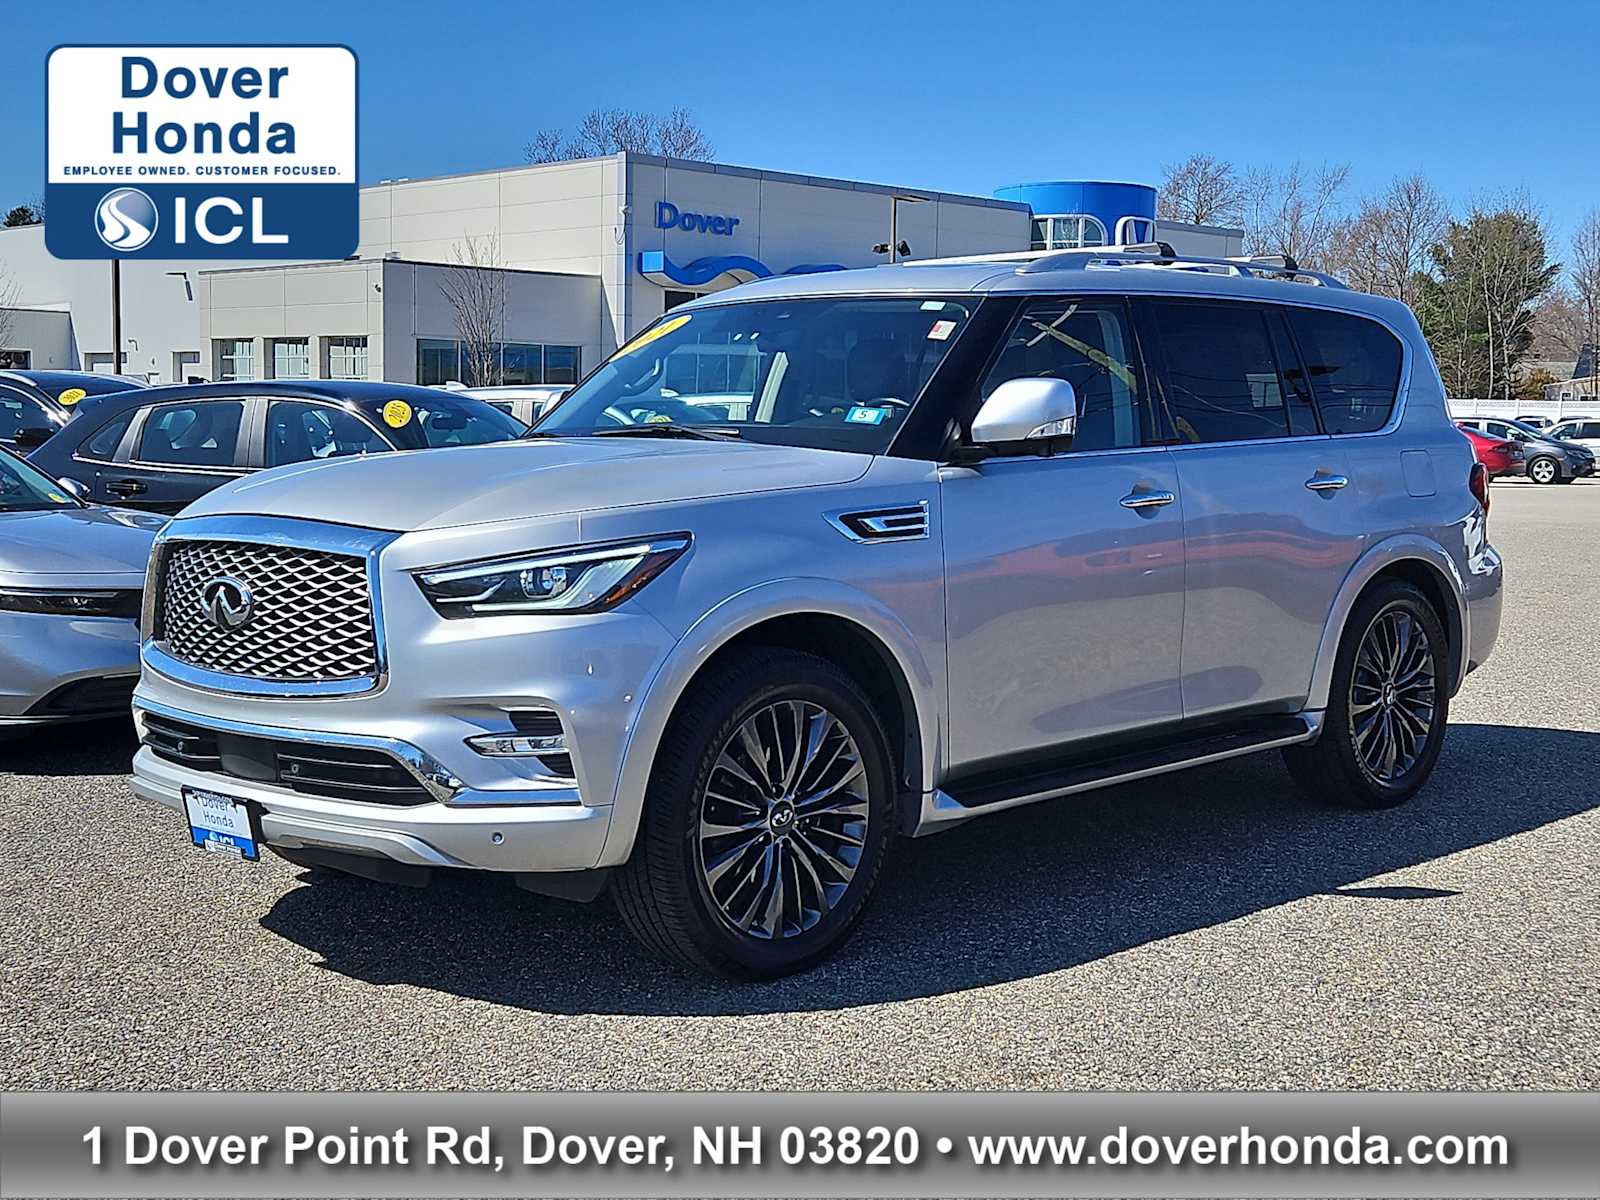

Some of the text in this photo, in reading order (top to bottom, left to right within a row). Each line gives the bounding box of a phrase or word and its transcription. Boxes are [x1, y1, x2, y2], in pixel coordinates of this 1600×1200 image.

[655, 200, 740, 236] Dover
[201, 797, 230, 812] Dover
[202, 810, 235, 828] Honda
